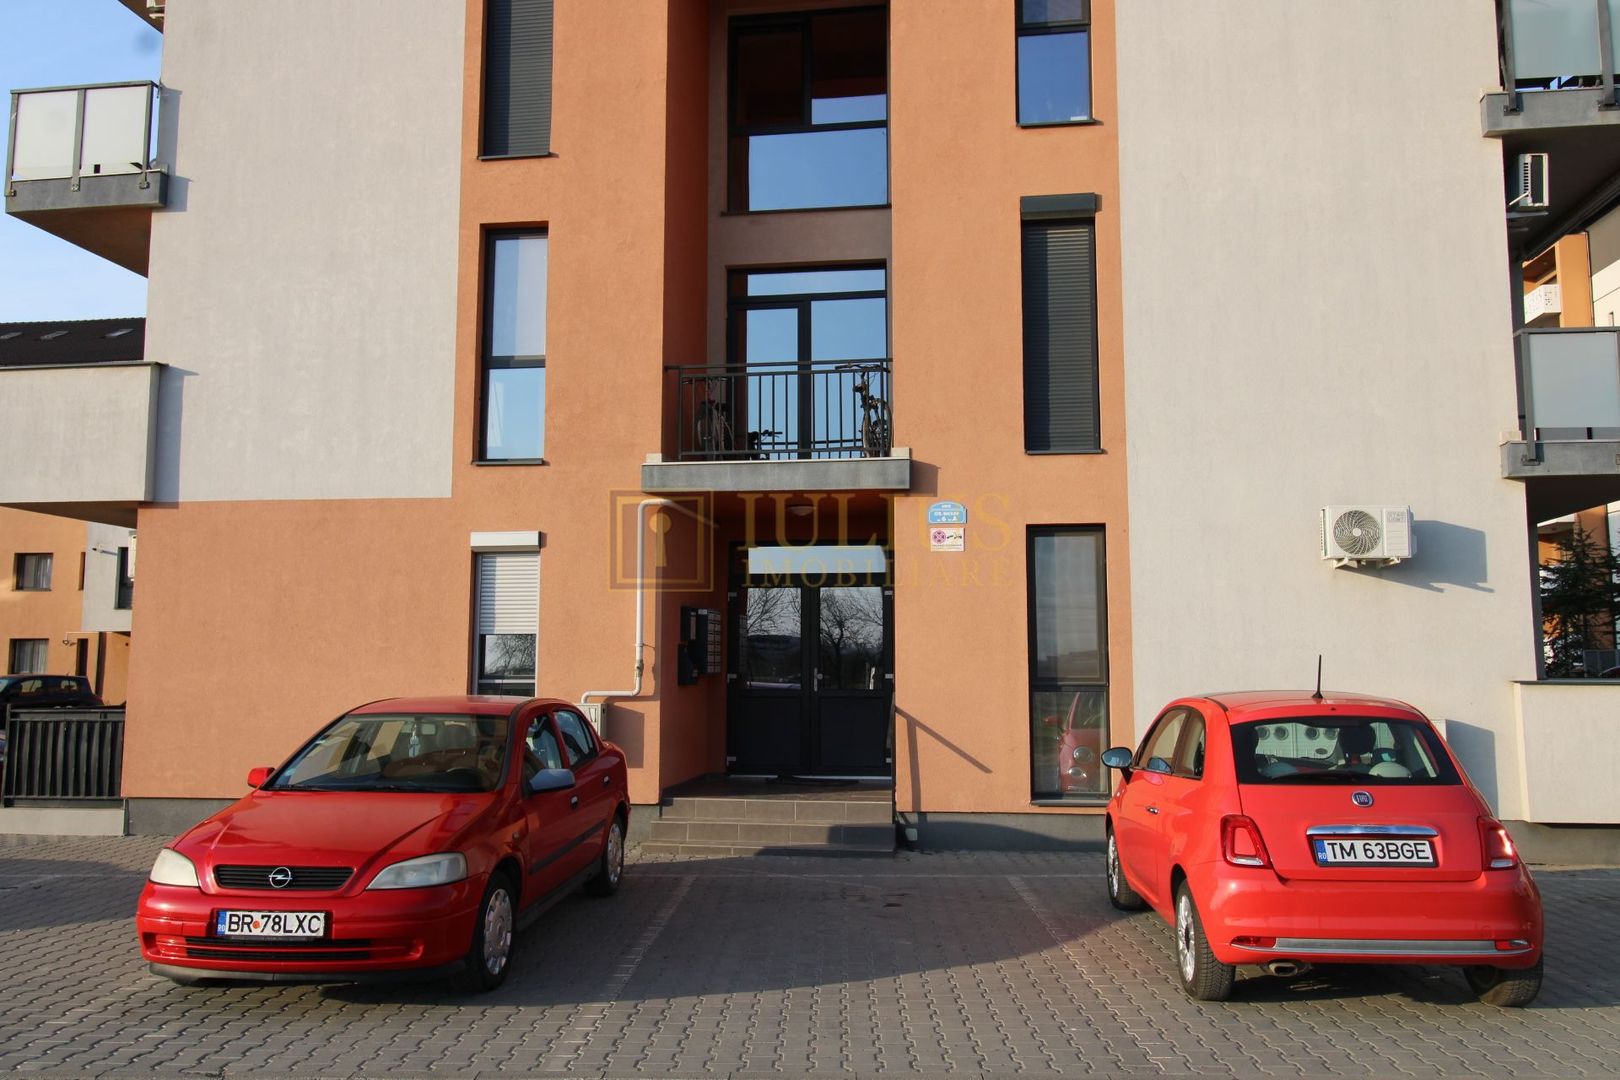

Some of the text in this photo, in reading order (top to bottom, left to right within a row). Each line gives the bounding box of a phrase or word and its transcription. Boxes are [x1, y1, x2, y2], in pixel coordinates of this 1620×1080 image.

[1327, 842, 1358, 860] TM
[1362, 842, 1430, 860] 63BGE
[228, 913, 254, 933] BR
[260, 914, 321, 934] 78LXC
